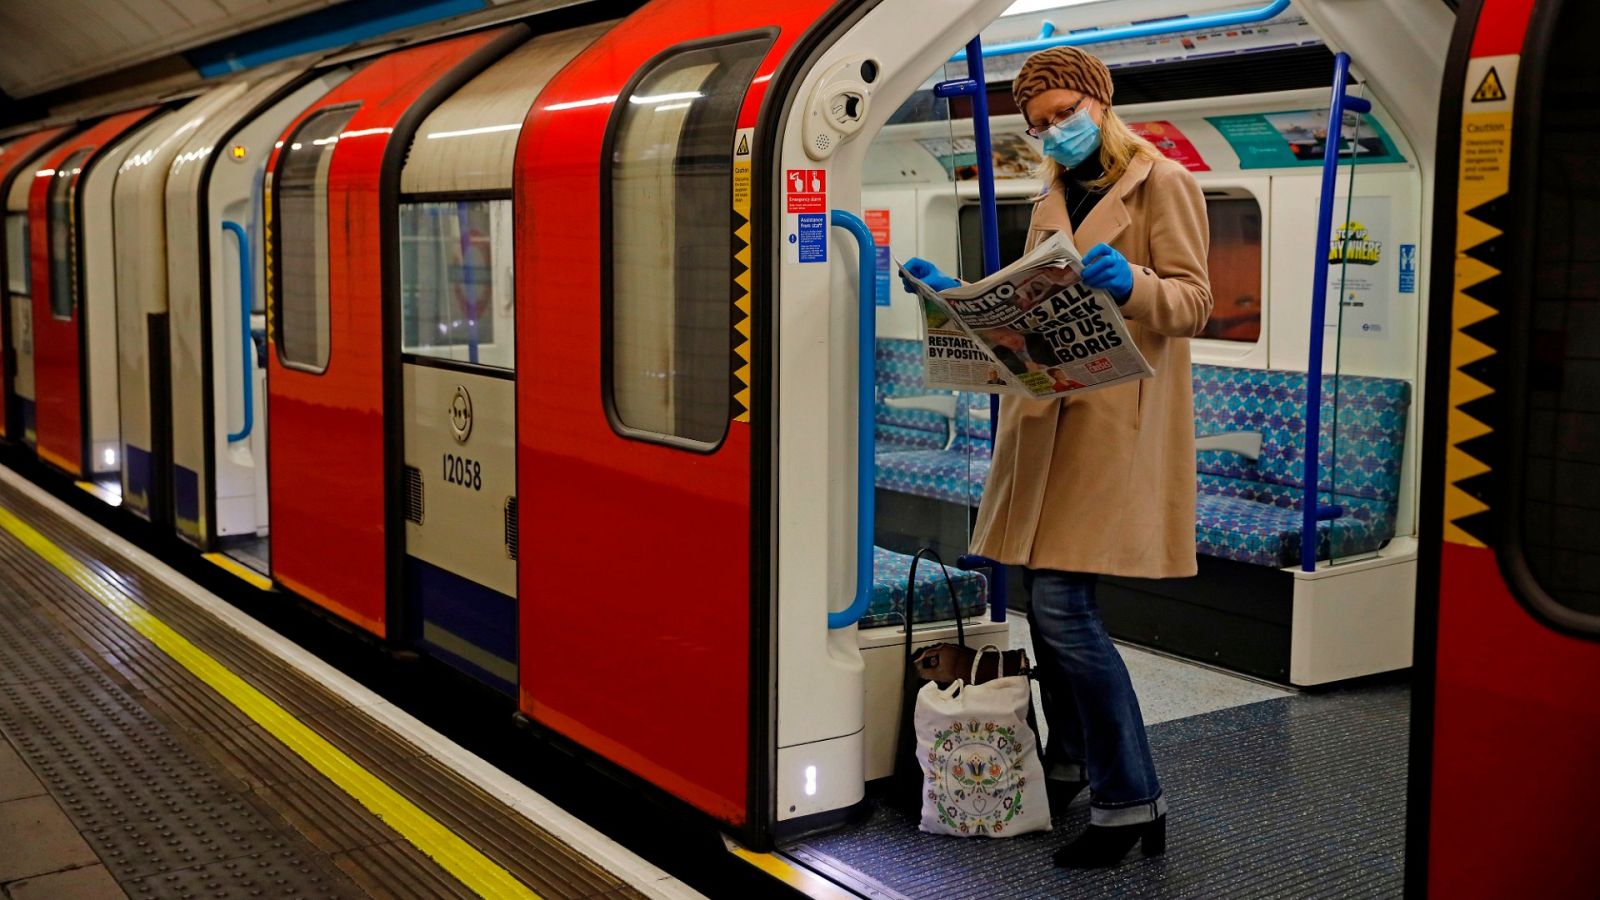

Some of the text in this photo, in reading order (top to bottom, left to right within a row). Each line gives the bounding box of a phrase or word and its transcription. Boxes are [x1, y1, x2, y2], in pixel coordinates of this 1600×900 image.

[1466, 123, 1505, 133] Caution
[953, 284, 1015, 313] METRO
[1007, 305, 1049, 331] IT'S
[1050, 283, 1093, 315] ALL
[1032, 296, 1104, 332] GREEK
[928, 335, 973, 350] RESTART
[1045, 313, 1112, 348] TO US,
[929, 347, 944, 358] BY
[1055, 331, 1123, 364] BORIS
[442, 453, 482, 491] 12058
